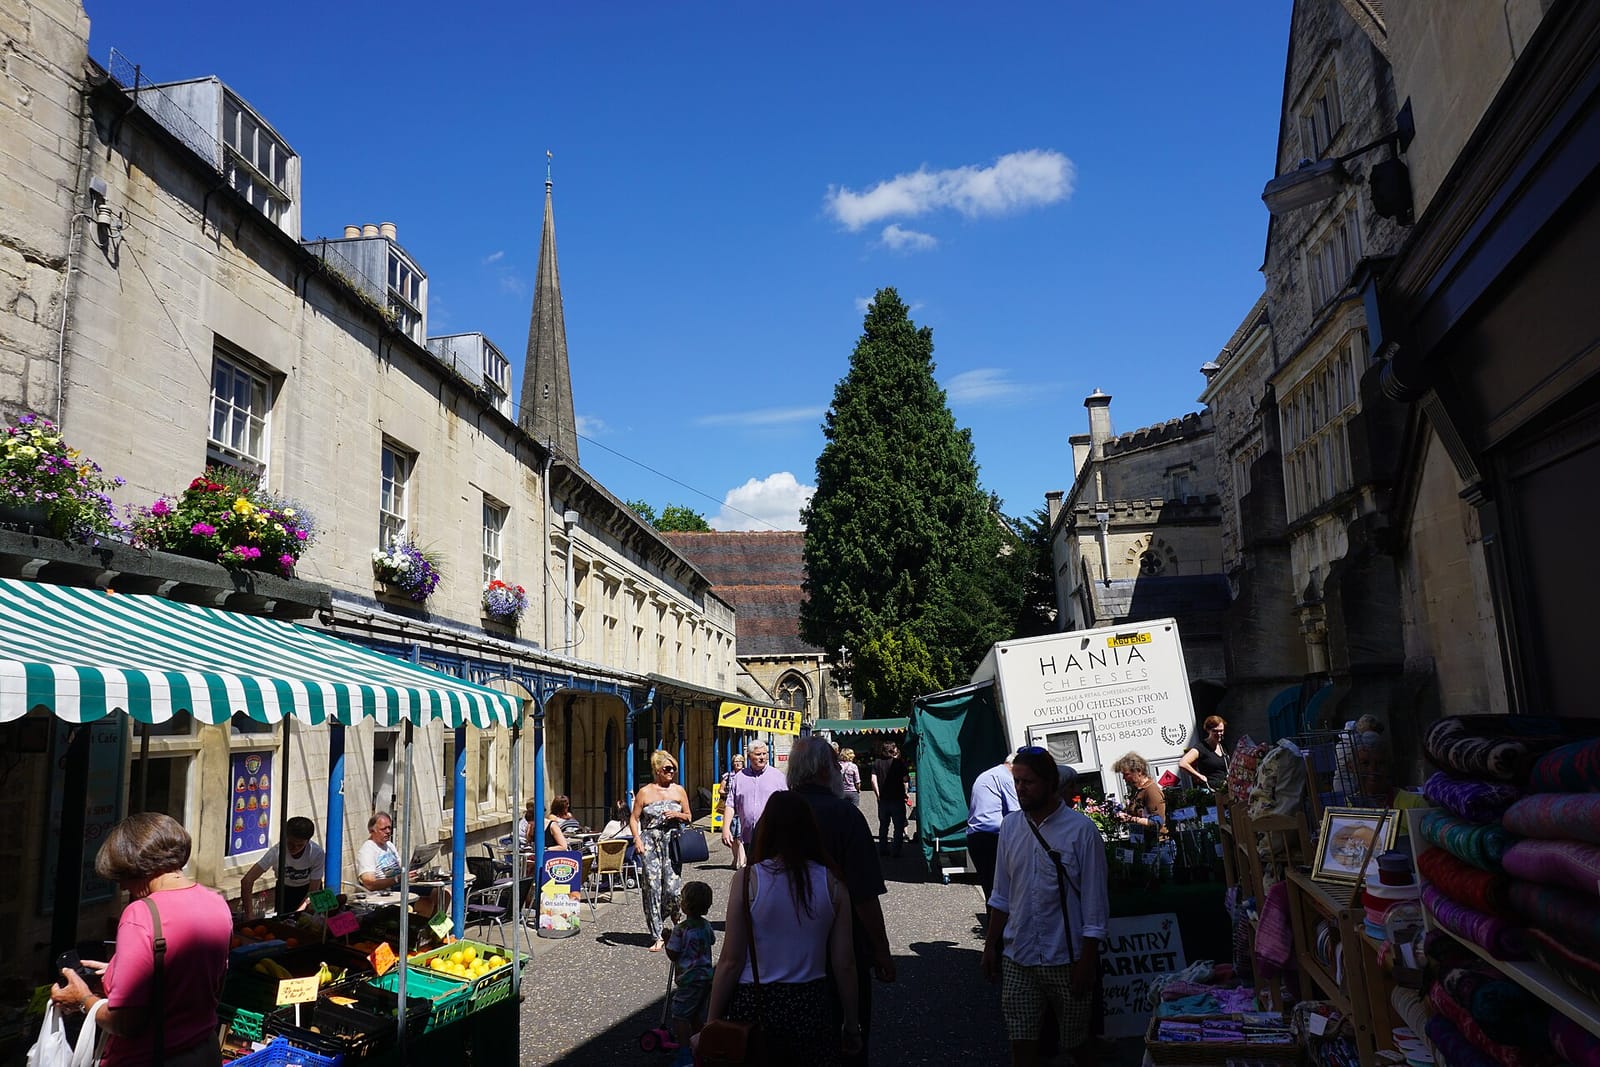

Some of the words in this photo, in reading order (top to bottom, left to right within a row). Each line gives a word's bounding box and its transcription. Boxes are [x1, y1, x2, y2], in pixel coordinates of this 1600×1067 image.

[1039, 645, 1146, 676] HANIA
[1043, 668, 1149, 692] CHEESES
[747, 706, 795, 721] INDOOR
[1034, 705, 1063, 717] OVER
[1064, 700, 1084, 715] 100
[1086, 695, 1135, 710] CHEESES
[1137, 691, 1169, 704] FROM
[1092, 711, 1107, 721] TO
[1109, 704, 1156, 719] CHOOSE
[745, 716, 796, 731] MARKET
[1095, 717, 1158, 732] LOUCESTERSHIRE
[1118, 727, 1154, 740] 884320
[1098, 931, 1171, 955] OUNTRY
[1100, 952, 1177, 977] ARKET
